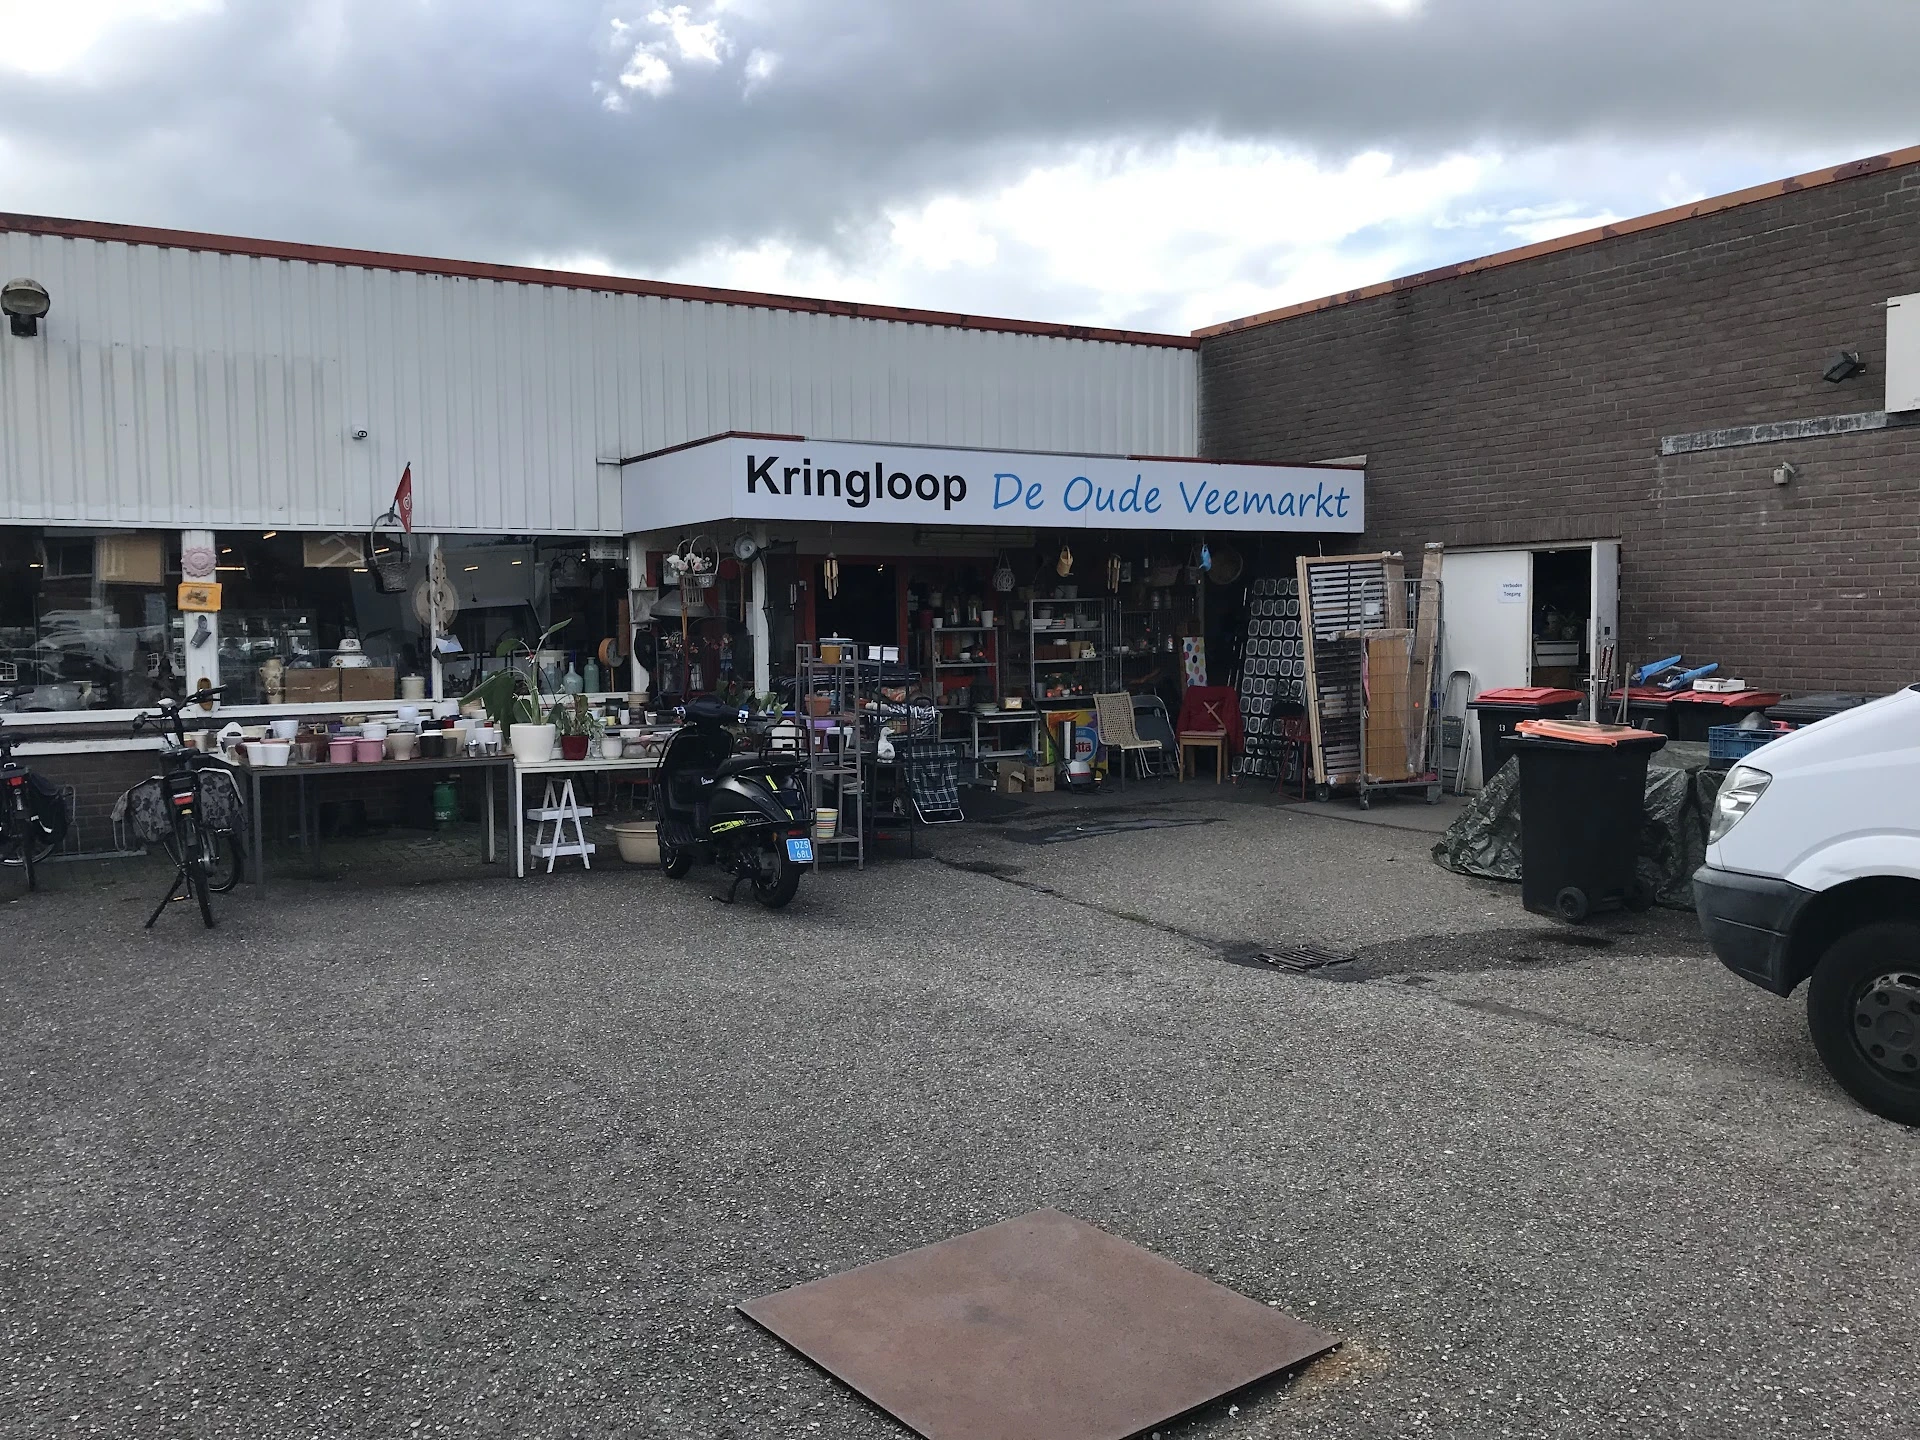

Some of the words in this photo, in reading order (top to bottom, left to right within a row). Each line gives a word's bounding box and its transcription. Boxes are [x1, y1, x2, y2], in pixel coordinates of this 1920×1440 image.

[746, 455, 967, 511] Kringloop
[993, 473, 1045, 510] De
[1063, 474, 1162, 513] Oude
[1179, 481, 1350, 518] Veemarkt
[794, 841, 809, 849] DZS
[796, 850, 811, 859] 68L
